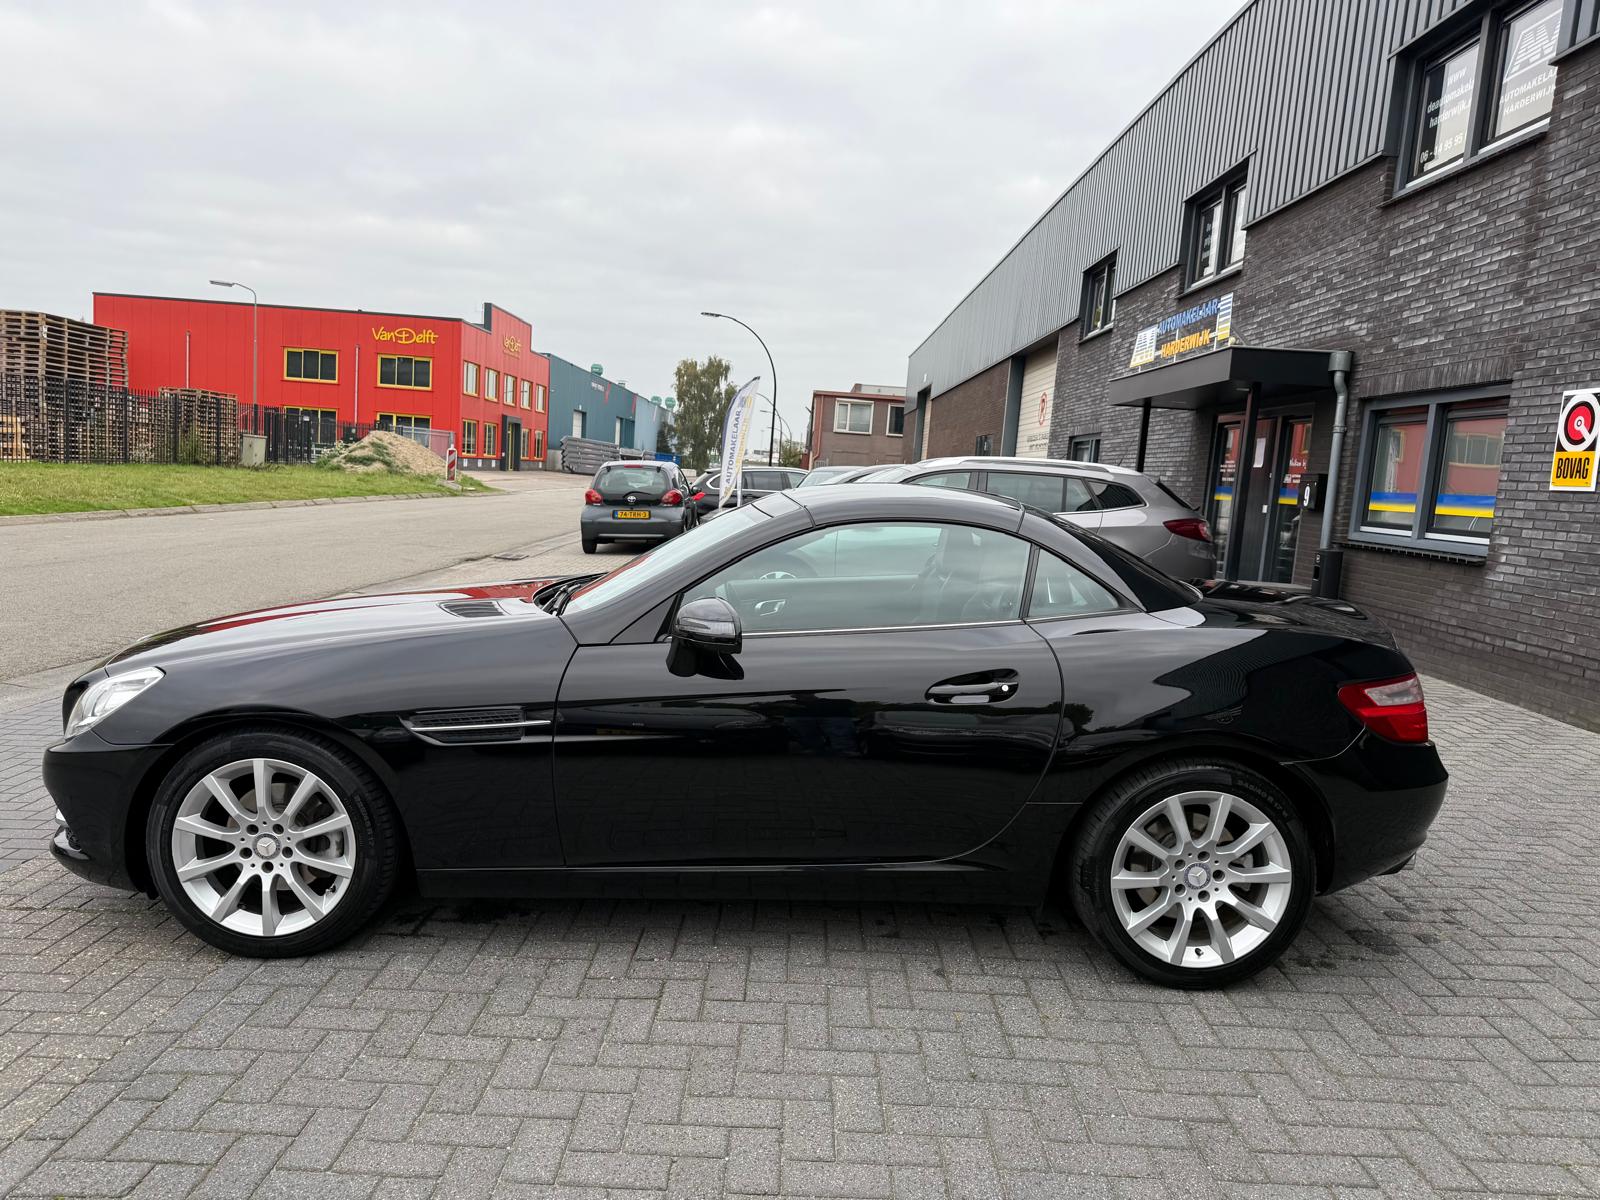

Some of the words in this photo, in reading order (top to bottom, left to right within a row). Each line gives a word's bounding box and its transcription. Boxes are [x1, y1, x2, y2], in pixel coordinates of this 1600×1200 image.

[1157, 298, 1218, 336] AUTOMAKELAAR
[1161, 329, 1211, 358] HARDERWIJK
[725, 410, 741, 484] AUTOMAKELAAR
[1556, 457, 1590, 479] BOVAG
[1303, 486, 1310, 507] 9
